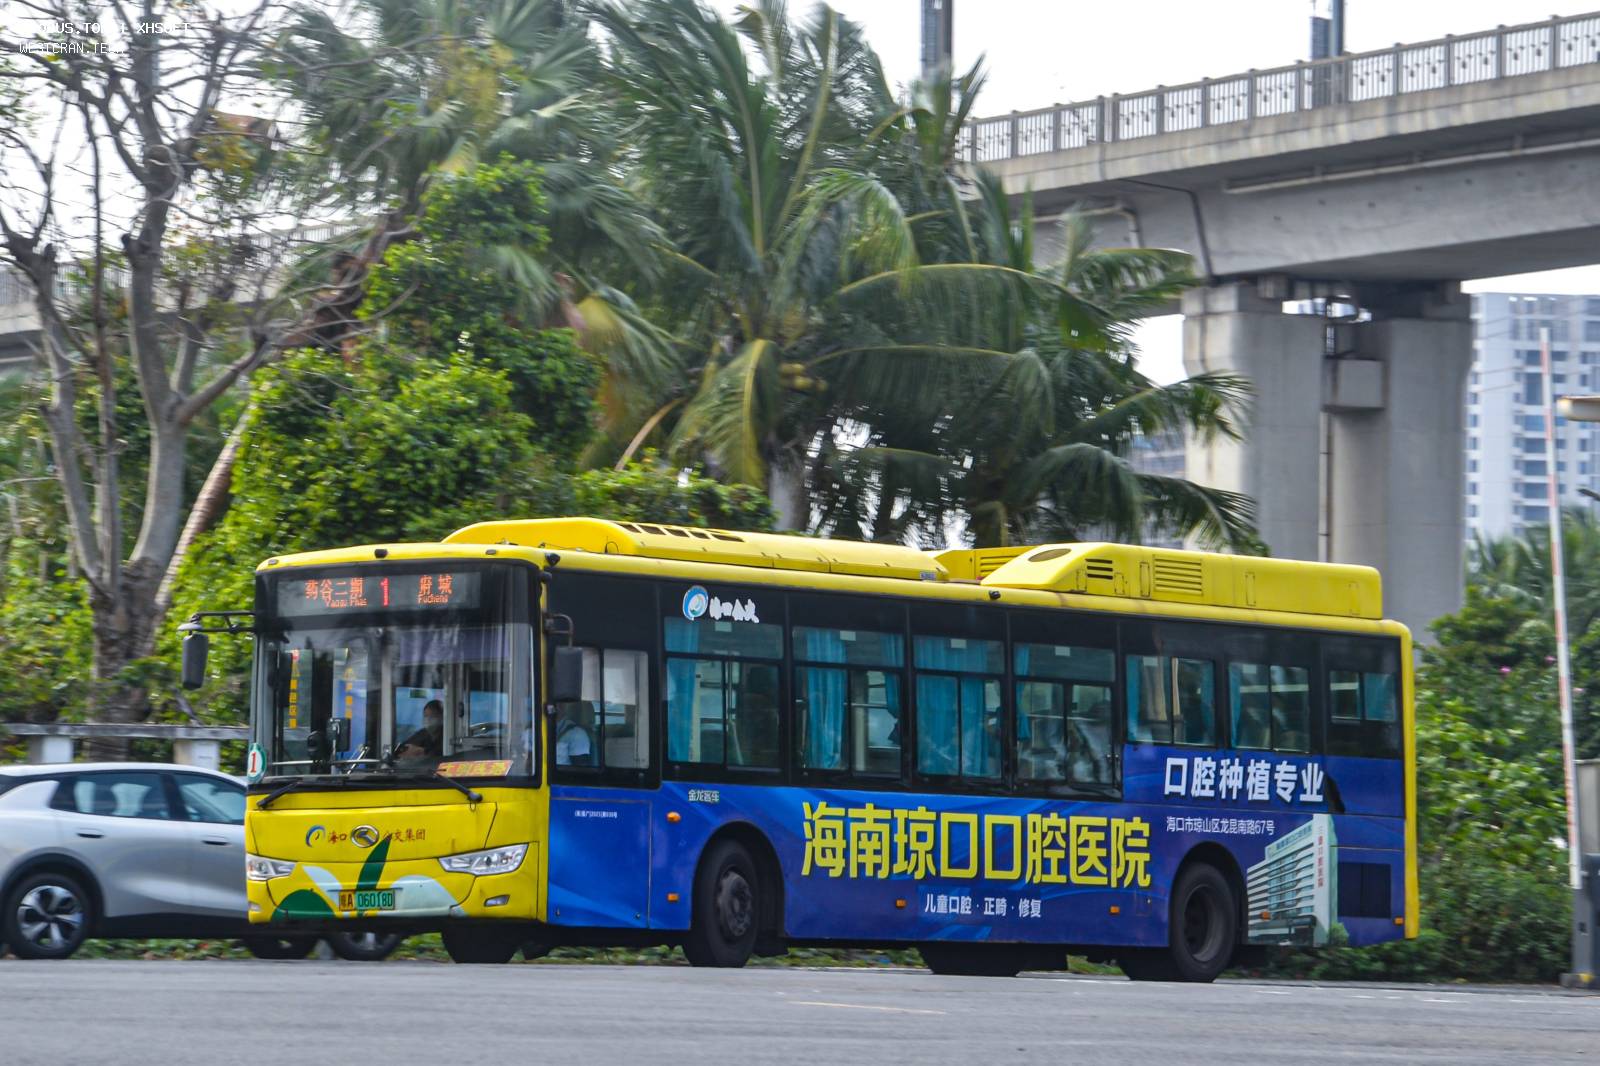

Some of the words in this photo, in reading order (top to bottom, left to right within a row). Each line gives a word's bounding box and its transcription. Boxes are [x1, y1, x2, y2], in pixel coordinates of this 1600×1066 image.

[379, 577, 389, 607] 1
[250, 752, 257, 773] 1
[1163, 756, 1325, 803] 口腔种植专业
[1166, 815, 1276, 836] 海口市琼山区龙昆南路67号
[800, 800, 1151, 888] 海南琼口口腔医院
